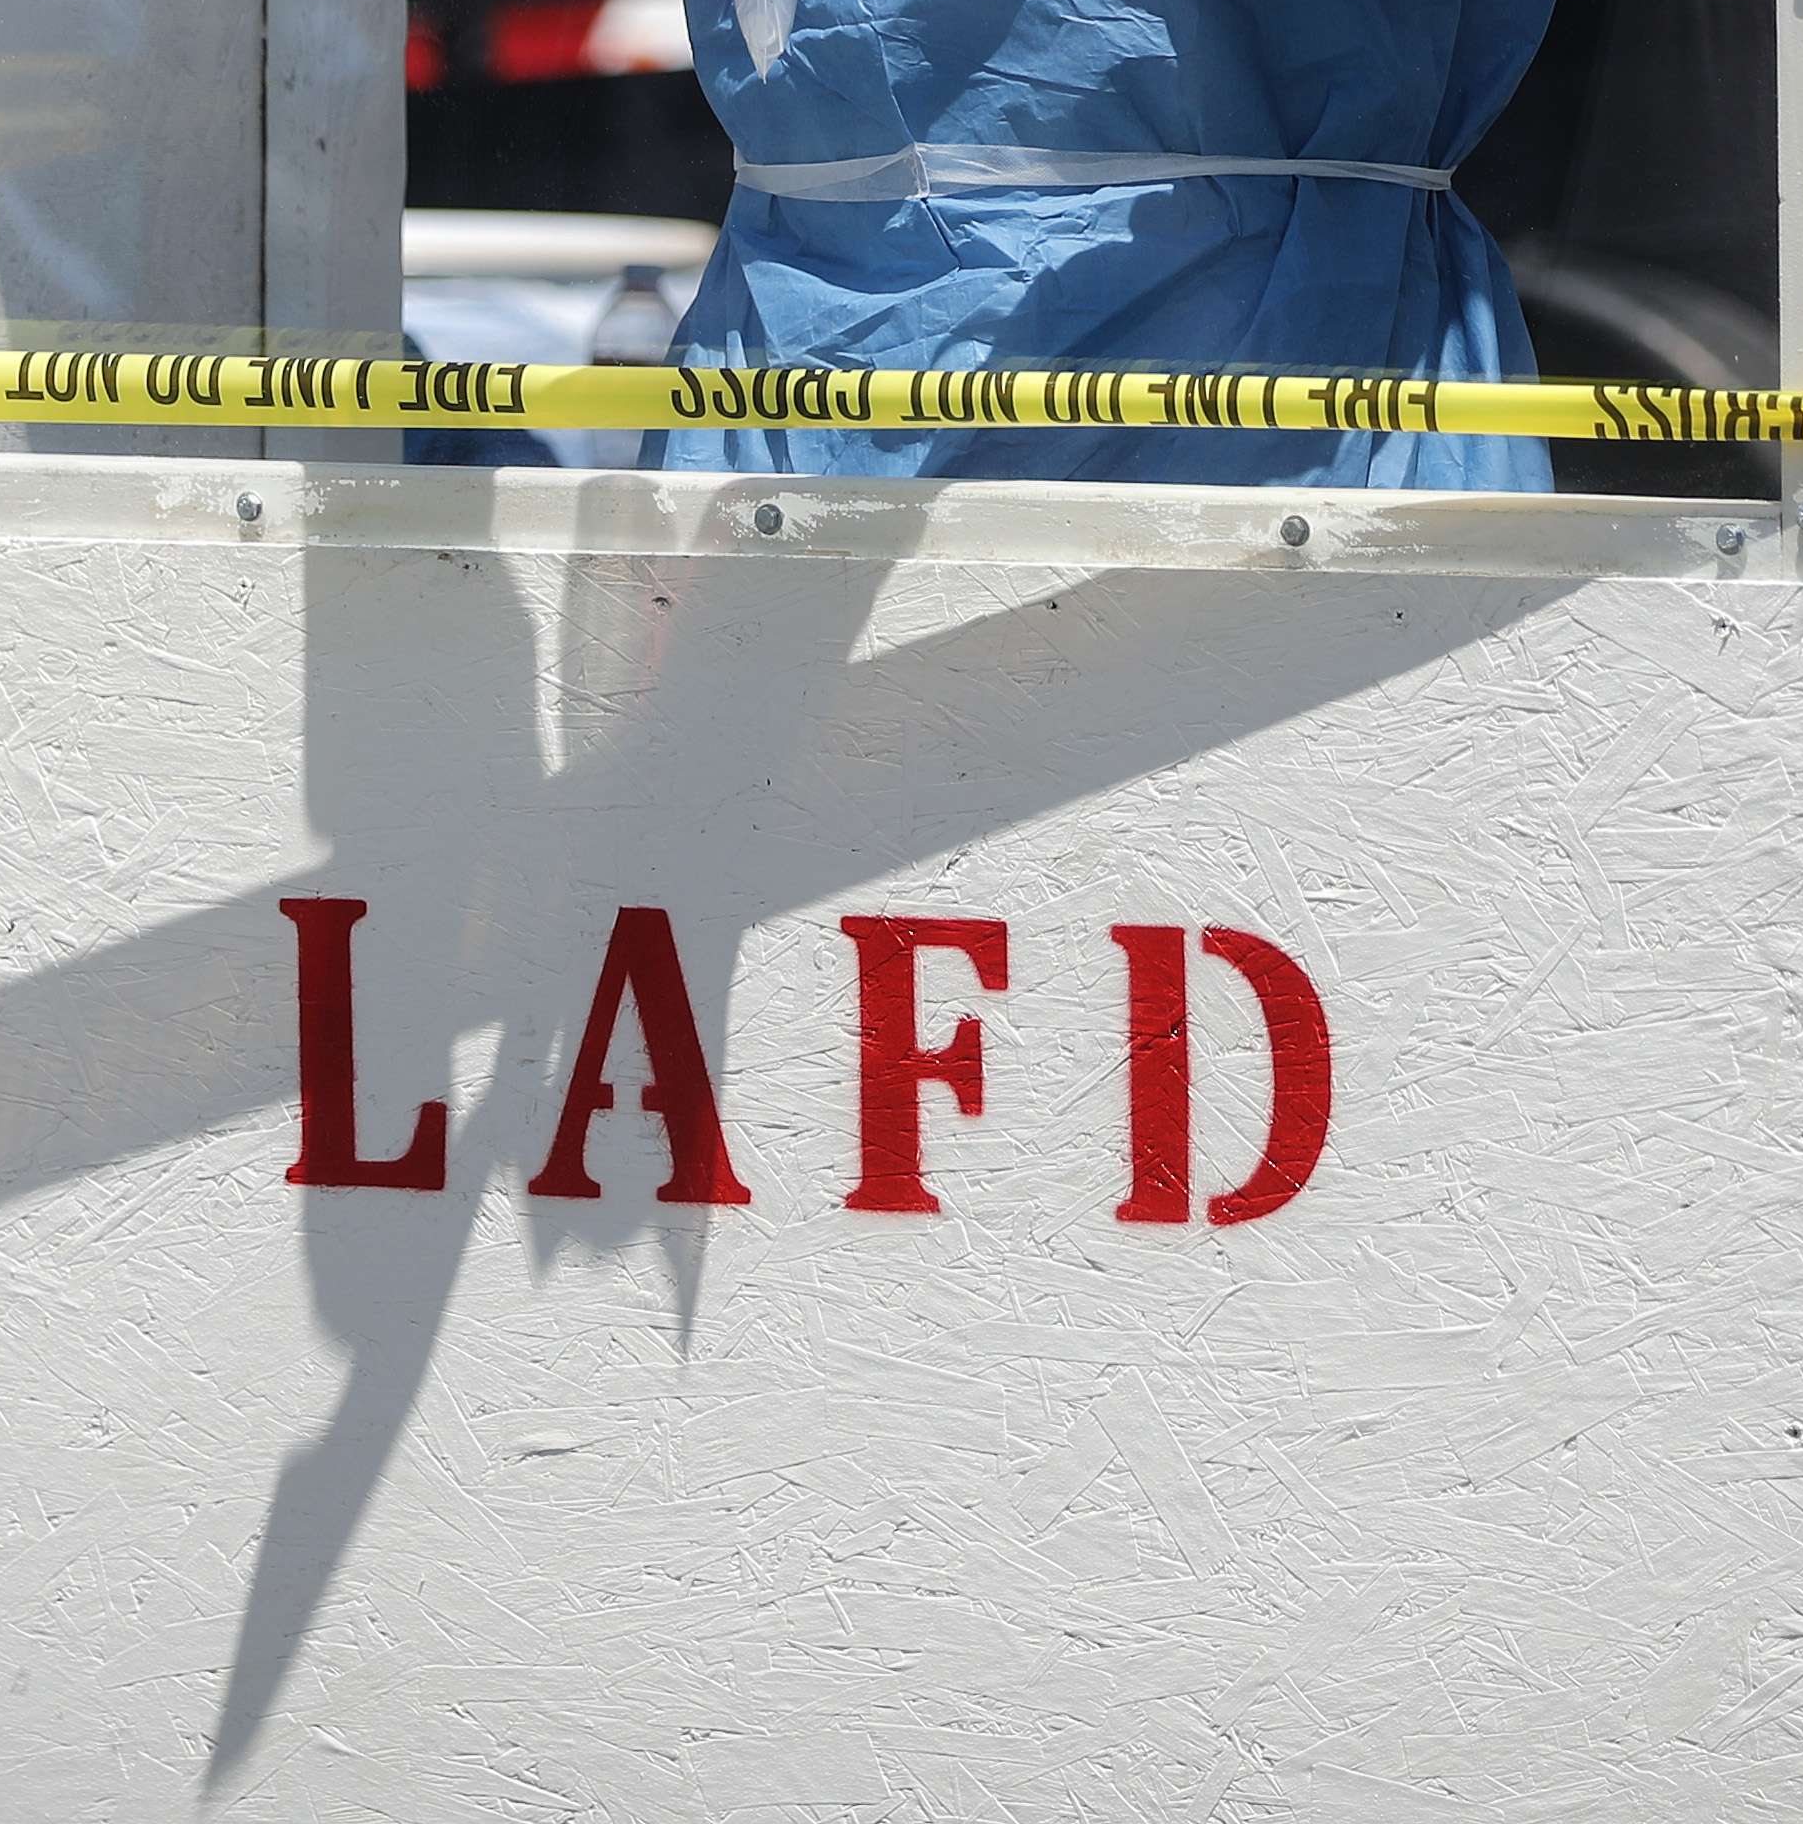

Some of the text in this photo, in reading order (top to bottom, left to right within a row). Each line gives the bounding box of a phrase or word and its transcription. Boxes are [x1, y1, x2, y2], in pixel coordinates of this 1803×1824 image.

[5, 351, 124, 403] NOT
[147, 354, 225, 406] DO
[399, 361, 527, 413] FIRE
[671, 367, 874, 421] CROSS
[900, 369, 1019, 423] NOT
[279, 897, 1332, 1226] LAFD
